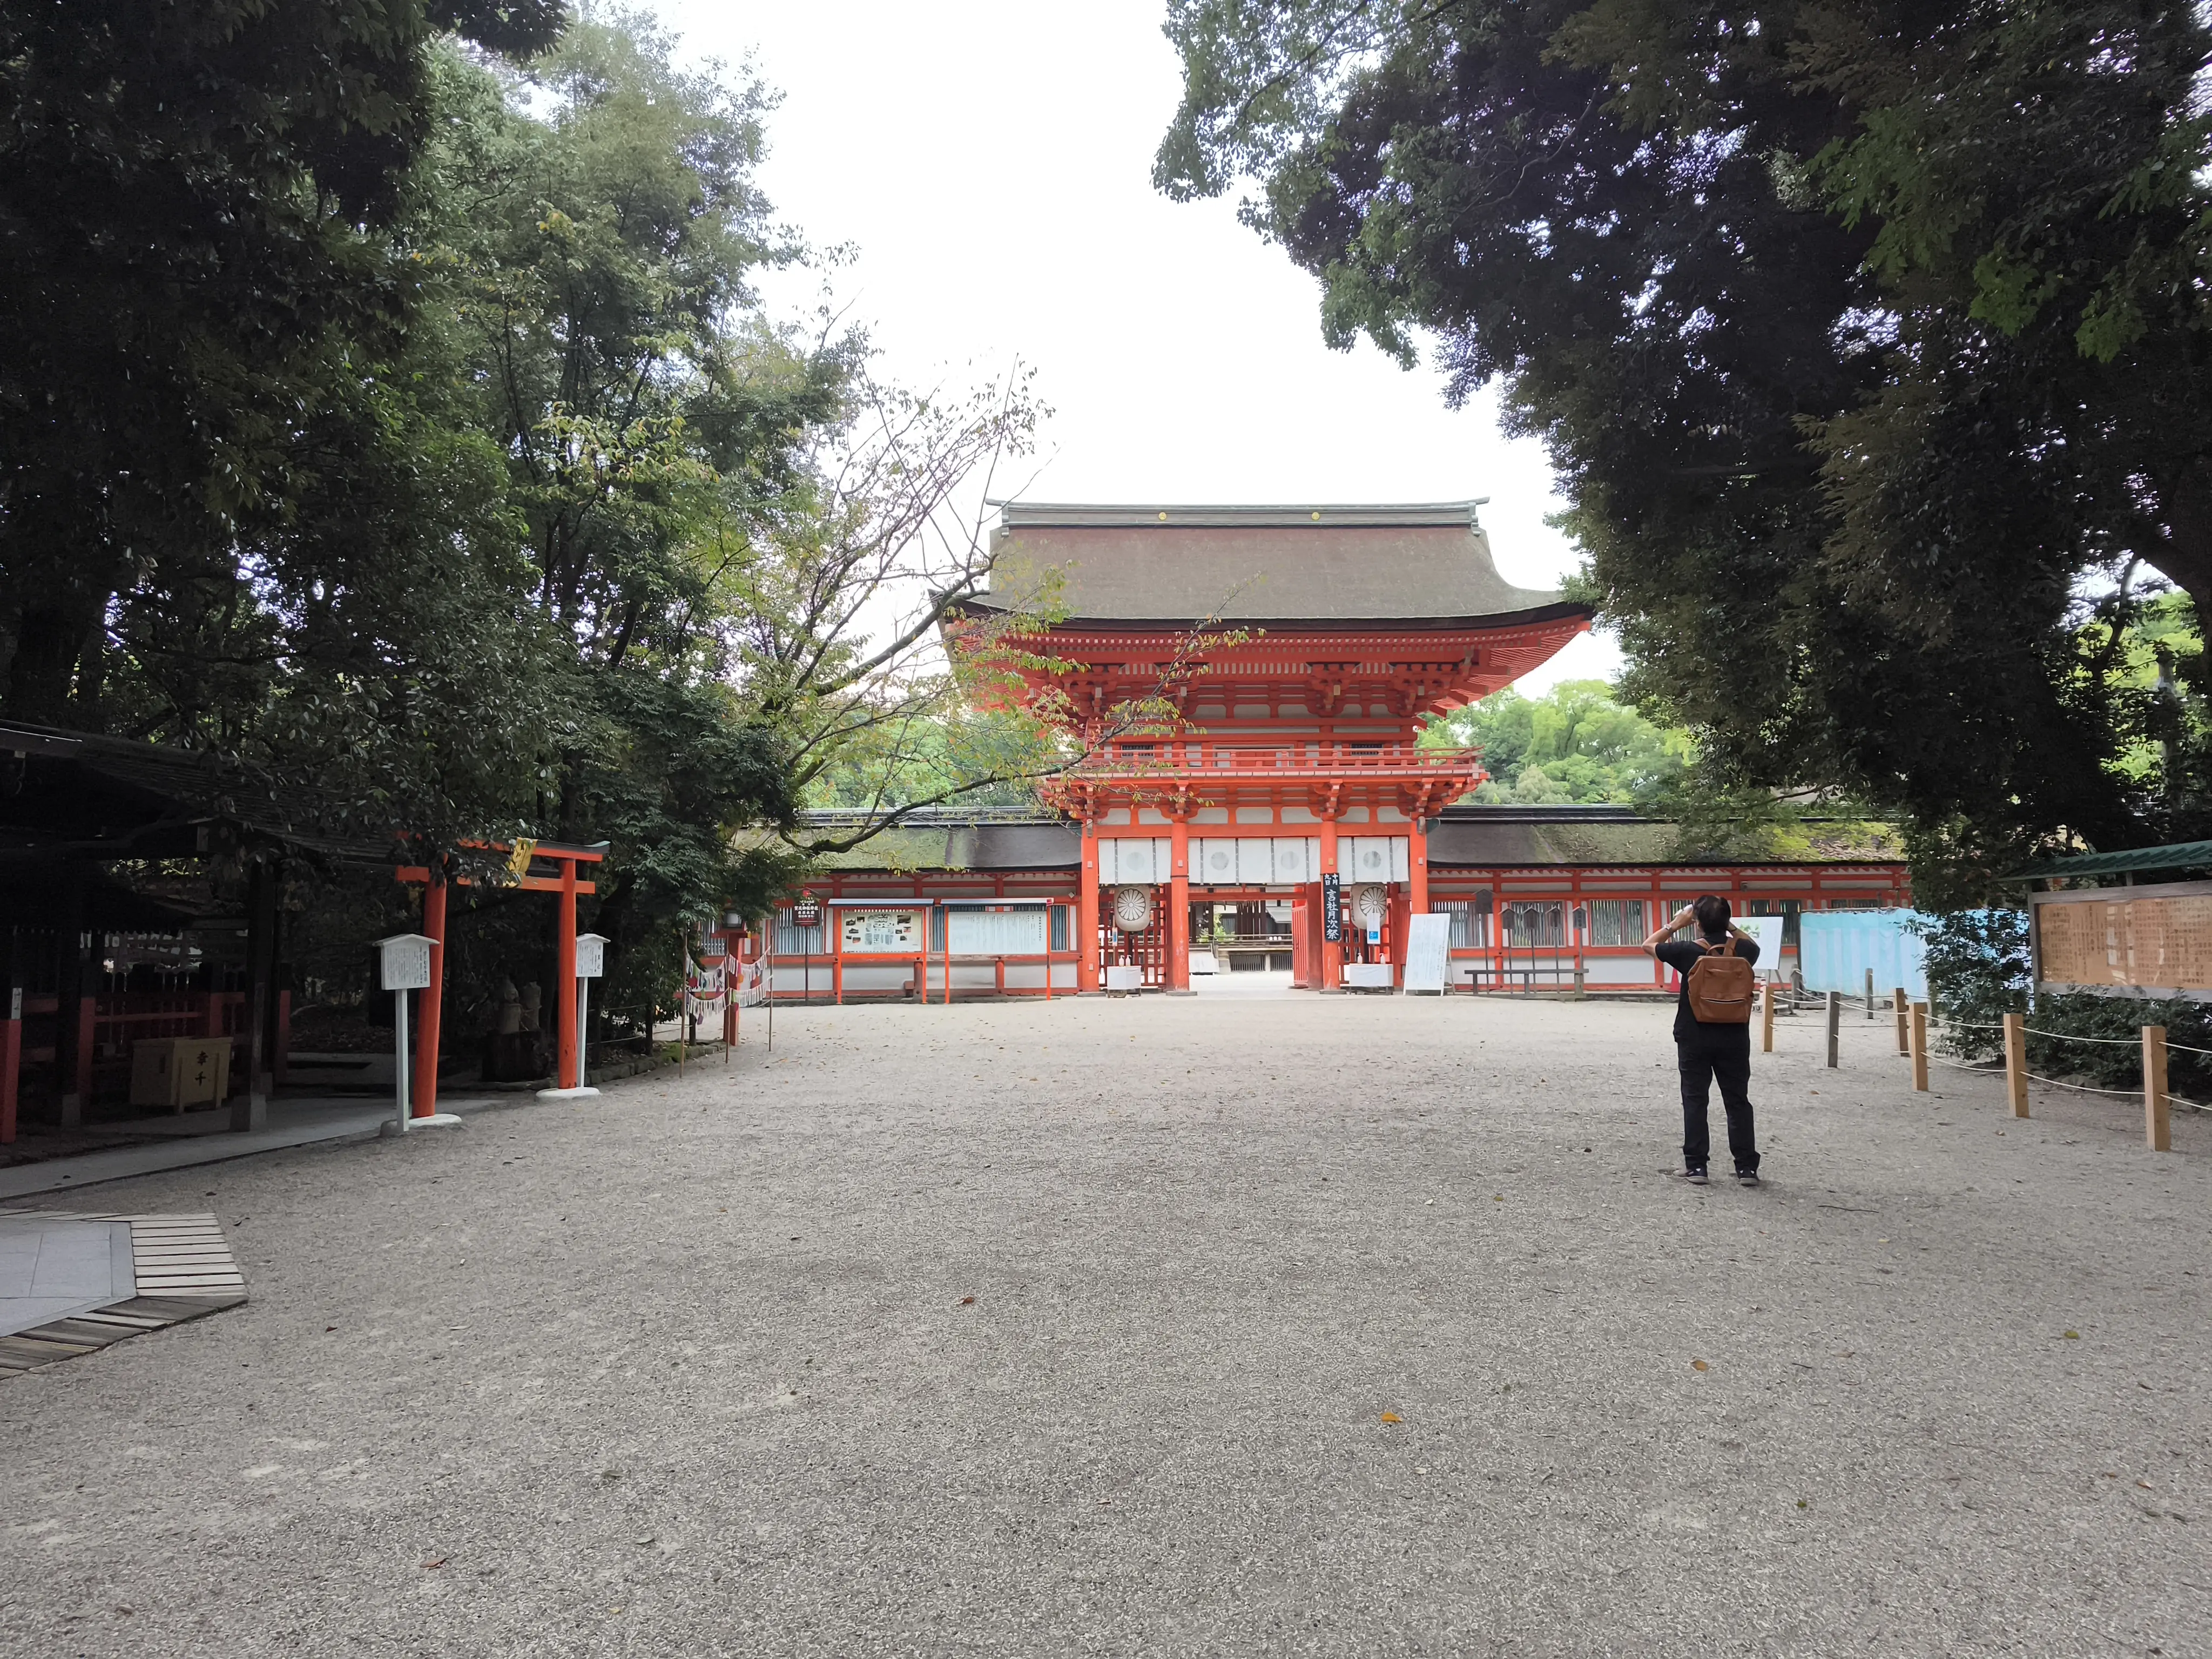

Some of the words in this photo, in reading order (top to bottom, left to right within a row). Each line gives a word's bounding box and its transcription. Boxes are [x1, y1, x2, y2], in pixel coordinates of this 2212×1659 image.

[1324, 873, 1332, 886] 九日
[1332, 873, 1338, 886] 十月
[1326, 889, 1339, 940] 言社月次祭
